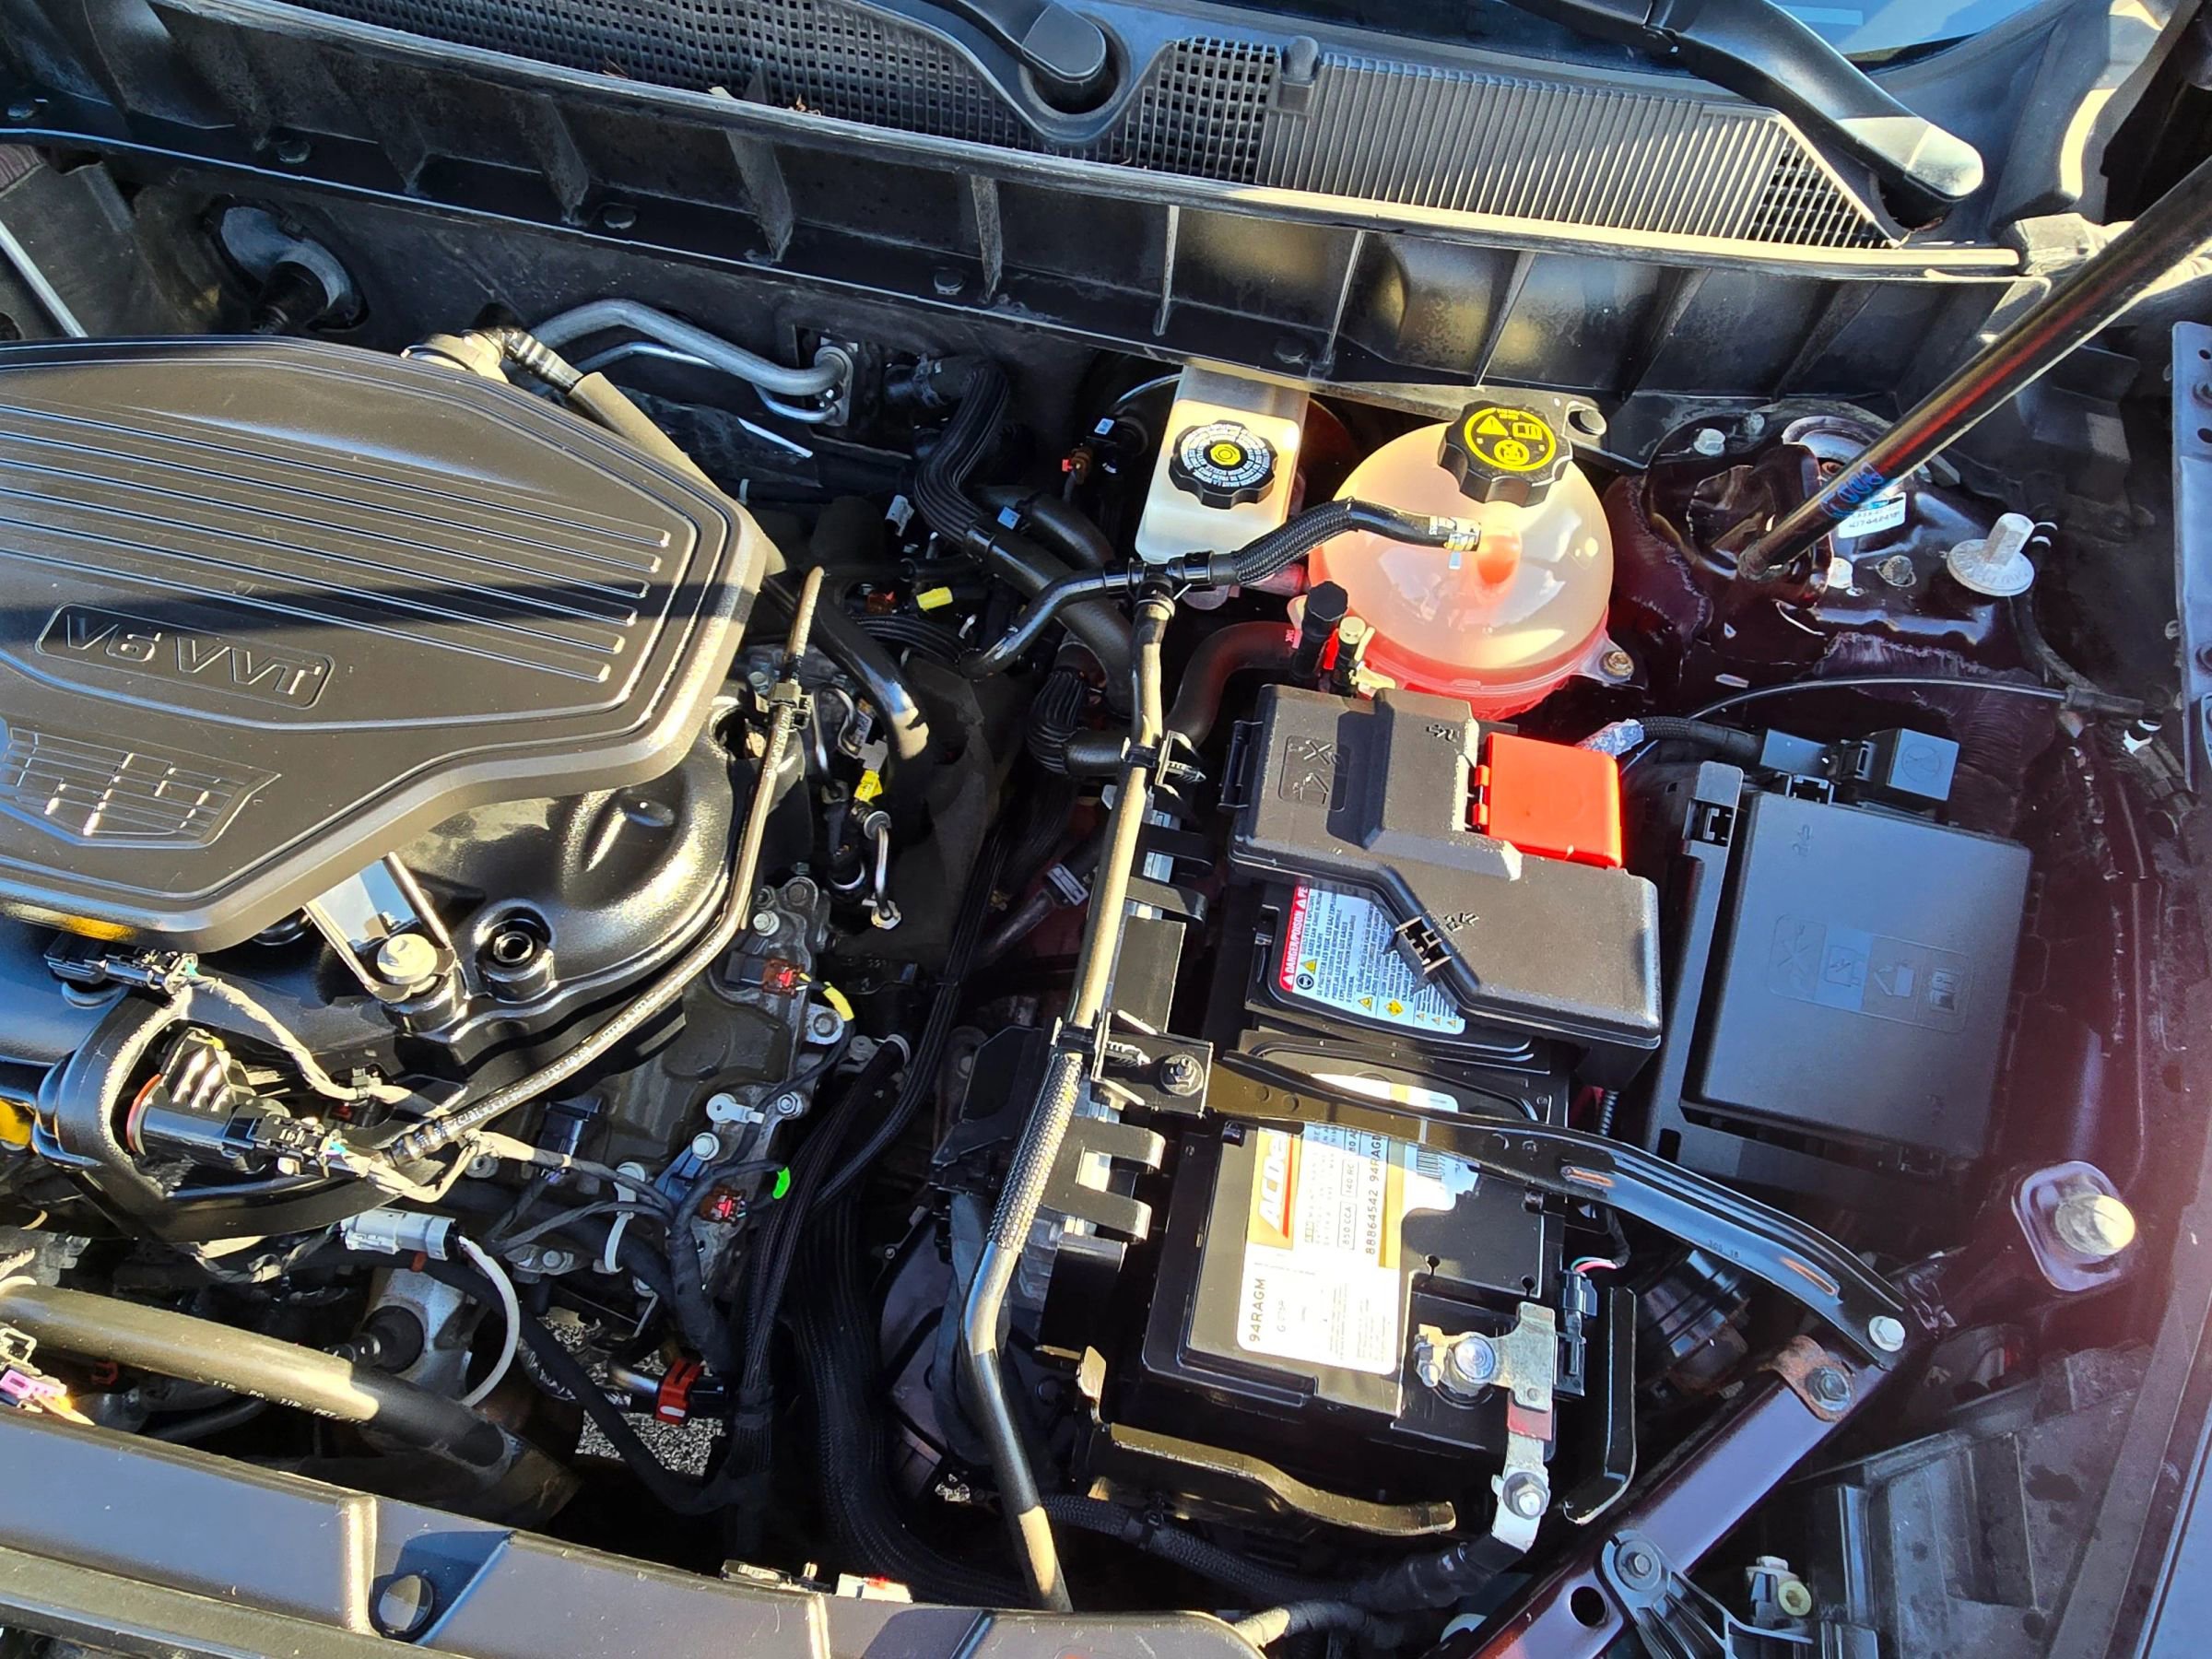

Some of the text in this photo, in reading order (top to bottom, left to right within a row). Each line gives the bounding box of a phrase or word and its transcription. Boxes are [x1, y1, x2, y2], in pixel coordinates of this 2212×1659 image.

[66, 614, 323, 696] V6 VVT
[1287, 910, 1303, 973] DANGER/POISON
[1365, 1188, 1379, 1255] 88864542
[1248, 1277, 1266, 1344] 94RAGM
